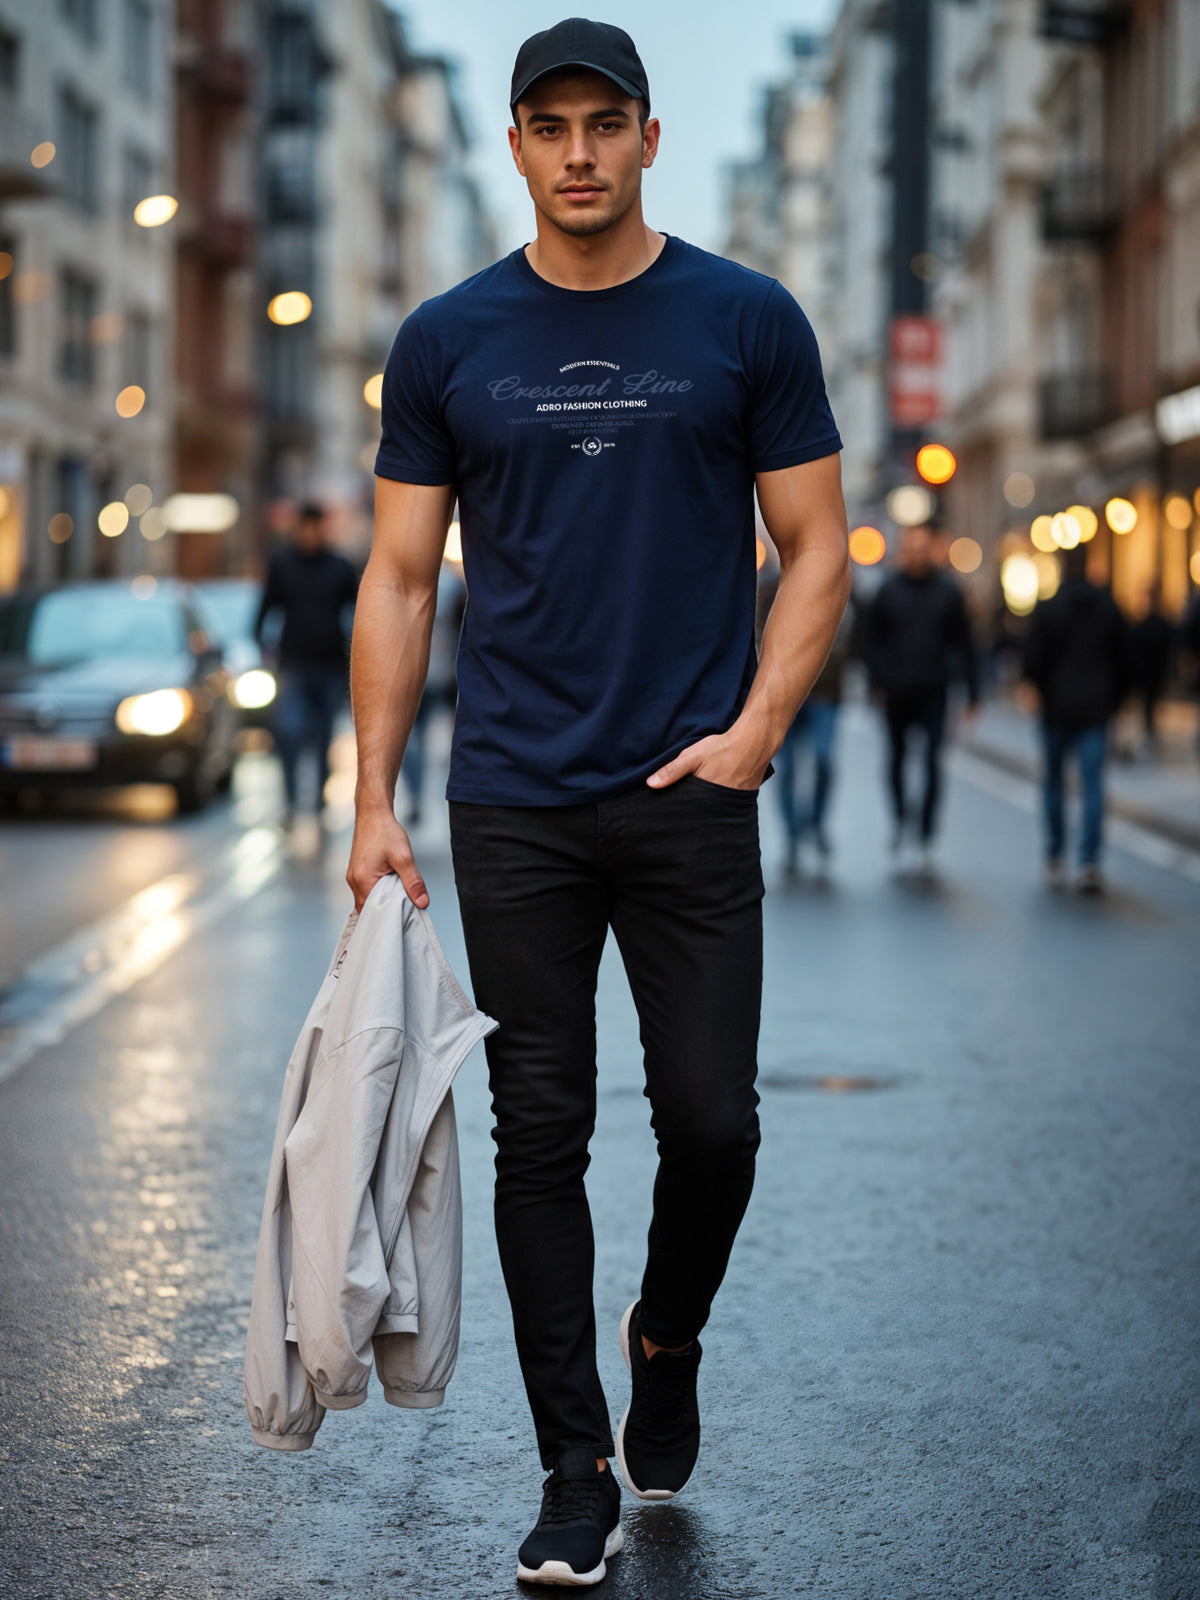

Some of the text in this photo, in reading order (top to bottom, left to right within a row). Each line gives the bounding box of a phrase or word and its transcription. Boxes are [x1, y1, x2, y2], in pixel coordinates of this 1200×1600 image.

[559, 360, 620, 373] MODERN ESSENTIALS
[487, 370, 695, 401] Crescent Line
[536, 399, 648, 412] ADRO FASHION CLOTHING
